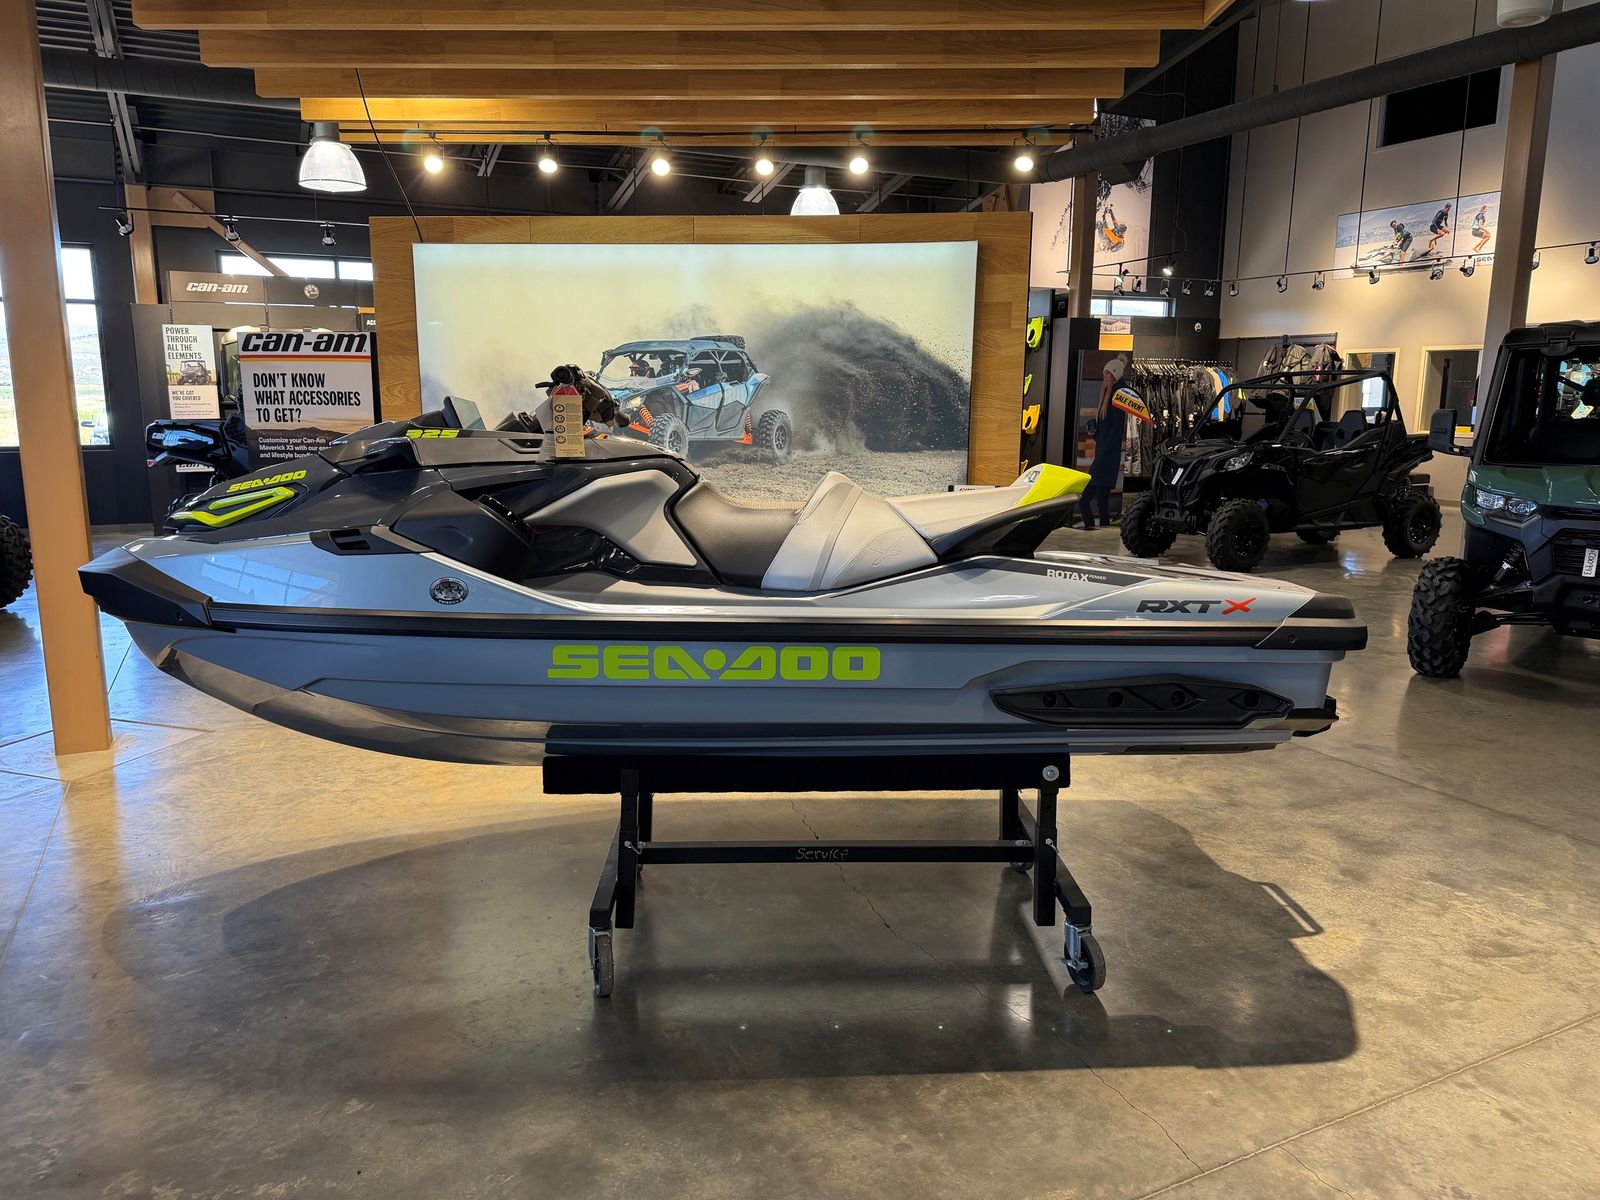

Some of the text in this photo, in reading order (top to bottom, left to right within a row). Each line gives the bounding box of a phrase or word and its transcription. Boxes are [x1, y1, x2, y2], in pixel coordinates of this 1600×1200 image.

[186, 282, 248, 294] can-am
[166, 335, 198, 343] THROUGH
[241, 333, 368, 353] can-am
[167, 344, 193, 352] ALL THE
[168, 352, 202, 360] ELEMENTS
[253, 373, 325, 388] DON'T KNOW
[254, 390, 361, 406] WHAT ACCESSORIES
[1115, 394, 1127, 404] SALE
[1128, 401, 1145, 412] EVENT
[256, 408, 302, 422] TO GET?
[258, 436, 288, 444] Customize
[405, 429, 460, 439] 325
[1046, 569, 1089, 582] ROTAX
[1136, 597, 1257, 616] RXT X
[795, 847, 850, 860] Service
